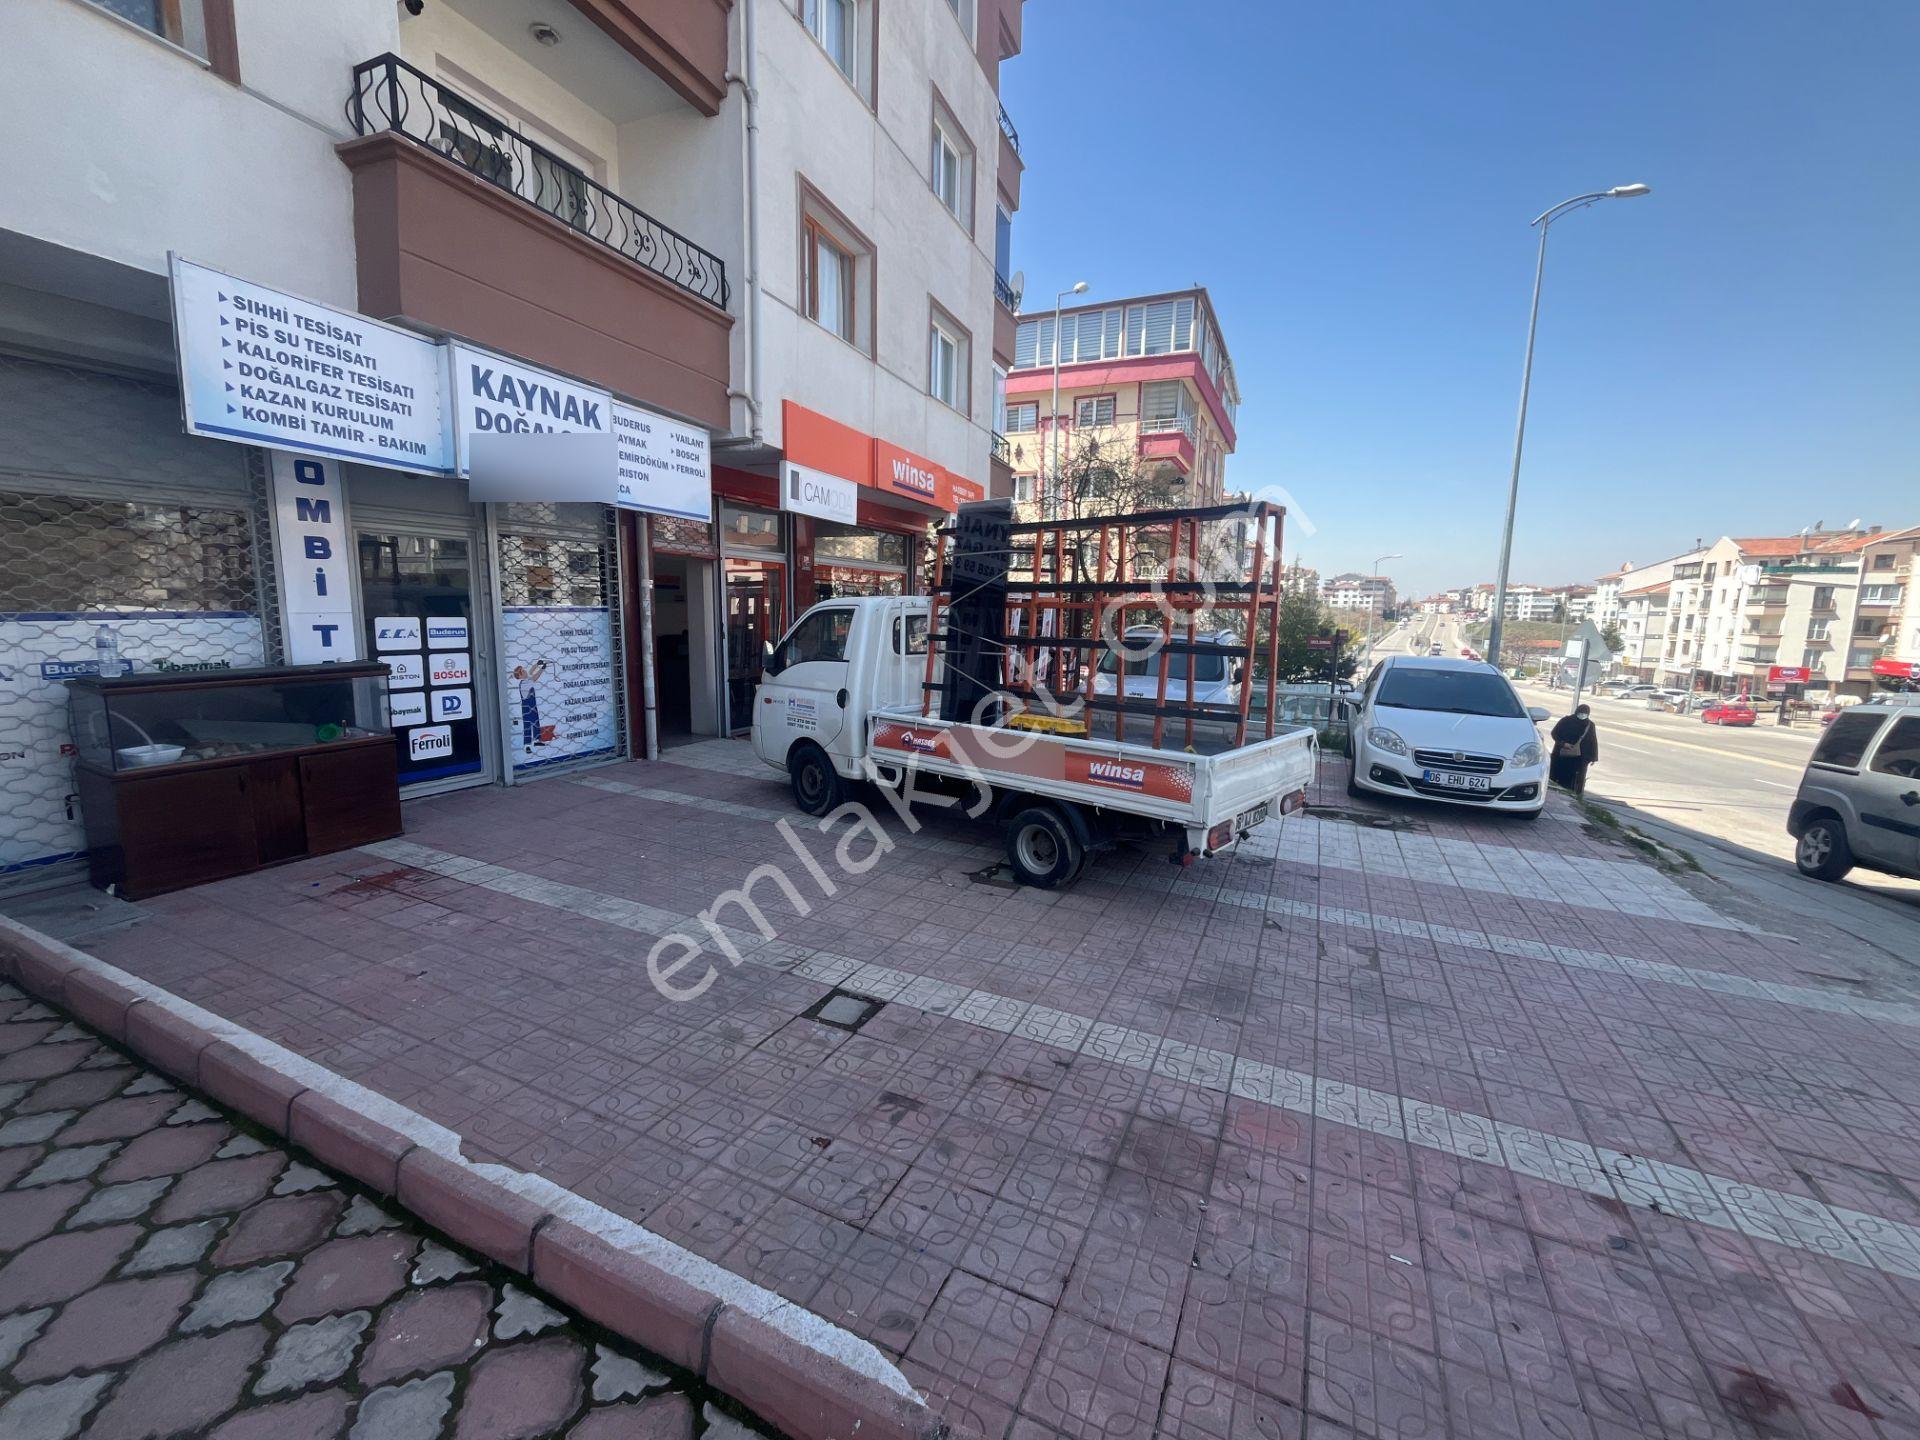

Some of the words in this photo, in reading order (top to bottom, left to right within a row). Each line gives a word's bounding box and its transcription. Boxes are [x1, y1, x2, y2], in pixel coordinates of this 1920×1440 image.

[233, 295, 289, 324] SIHHİ
[293, 313, 363, 347] TESİSAT
[235, 317, 269, 339] PİS
[274, 330, 300, 348] SU
[304, 338, 377, 371] TESİSATI
[237, 339, 344, 380] KALORİFER
[348, 370, 415, 400] TESİSATI
[238, 361, 343, 400] DOĞALGAZ
[346, 389, 412, 417] TESİSATI
[471, 364, 602, 430] KAYNAK
[240, 384, 307, 411] KAZAN
[312, 400, 394, 430] KURULUM
[242, 405, 307, 431] KOMBİ
[310, 420, 364, 443] TAMİR
[378, 434, 427, 456] BAKIM
[613, 415, 651, 434] BUDERUS
[618, 434, 647, 449] AYMAK
[619, 450, 669, 470] EMİRDÖKÜM
[676, 448, 700, 463] BOSCH
[618, 467, 650, 482] RISTON
[892, 458, 935, 491] winsa
[617, 484, 631, 495] CA
[429, 628, 466, 637] Buderus
[45, 663, 130, 675] Budes
[388, 673, 421, 681] RISTON
[434, 670, 468, 680] BOSCH
[412, 734, 450, 754] Ferroli
[1090, 760, 1145, 782] winsa
[1430, 772, 1440, 782] 06
[1448, 775, 1465, 785] EHU
[1469, 777, 1486, 788] 624
